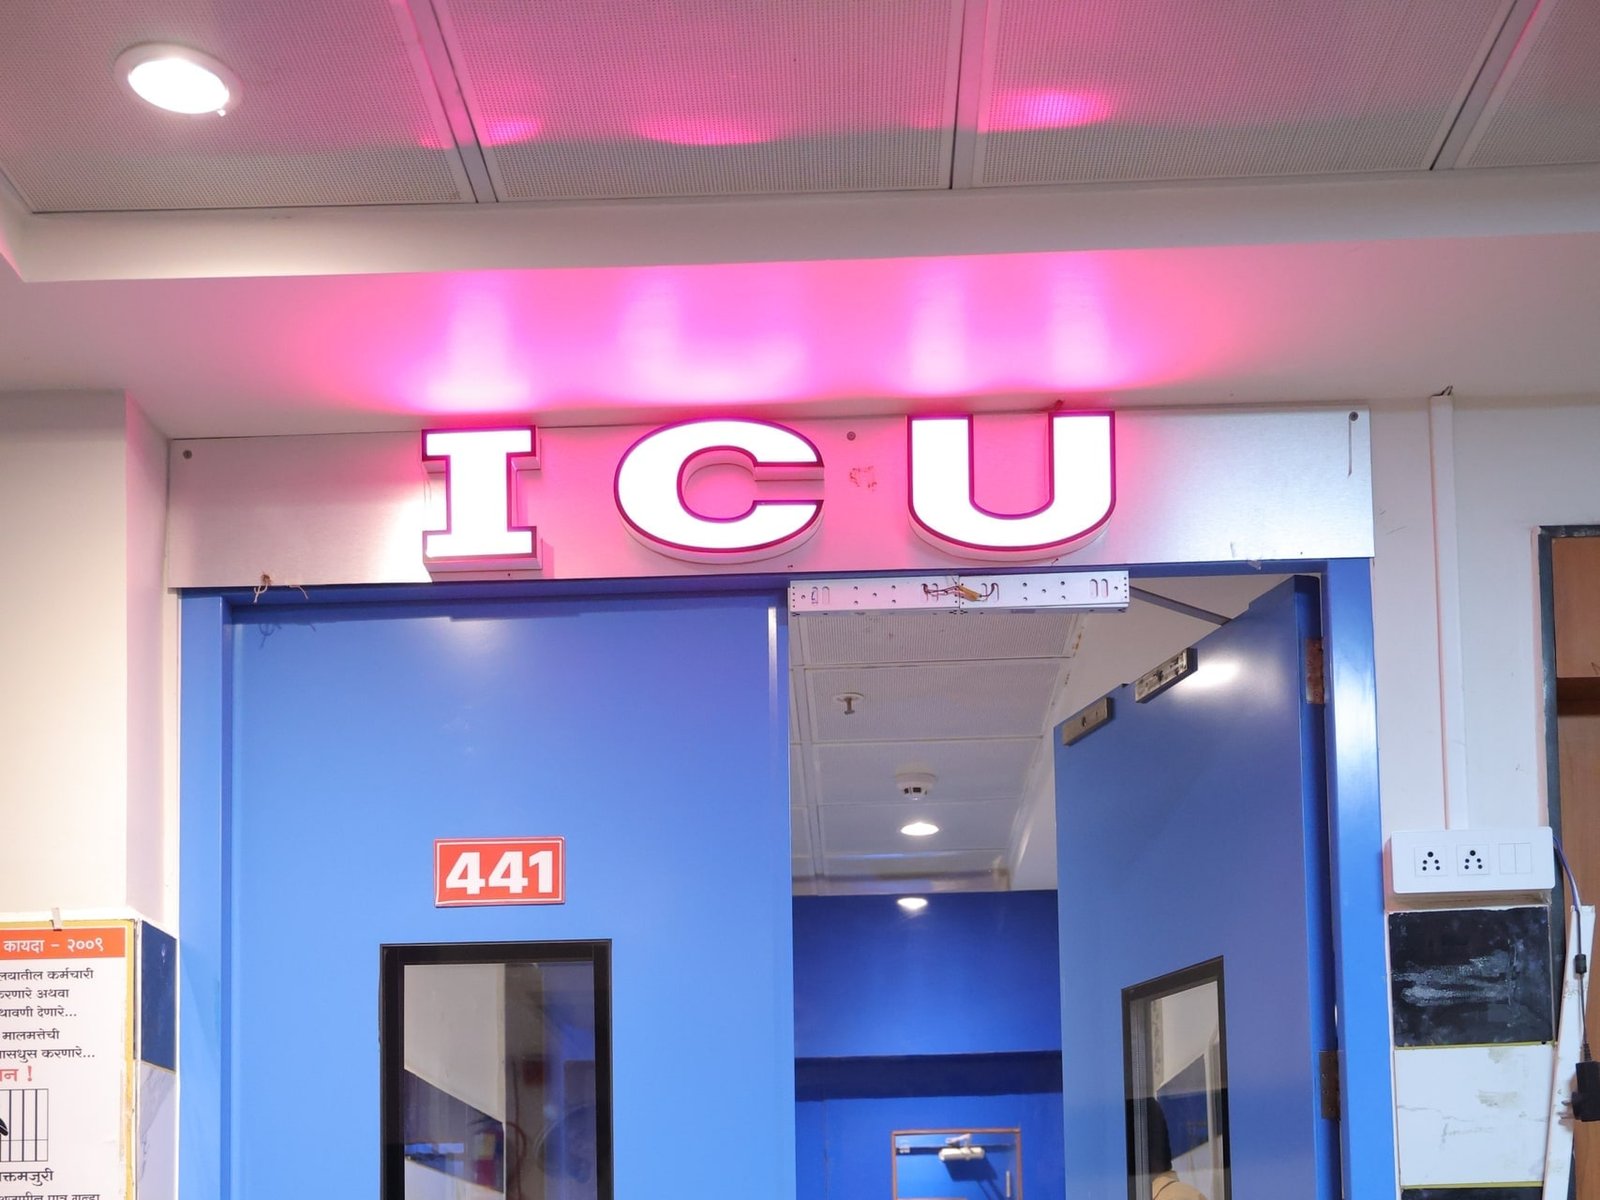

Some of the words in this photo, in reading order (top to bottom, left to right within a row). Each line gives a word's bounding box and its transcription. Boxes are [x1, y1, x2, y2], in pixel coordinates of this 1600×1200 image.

[421, 411, 1117, 558] ICU
[445, 850, 553, 895] 441
[3, 939, 45, 953] कायदा
[67, 937, 104, 952] २००९
[47, 967, 94, 980] कर्मचारी
[37, 989, 69, 999] अथवा
[2, 1028, 60, 1040] मालमत्तेची
[0, 1168, 54, 1186] क्तमजुरी
